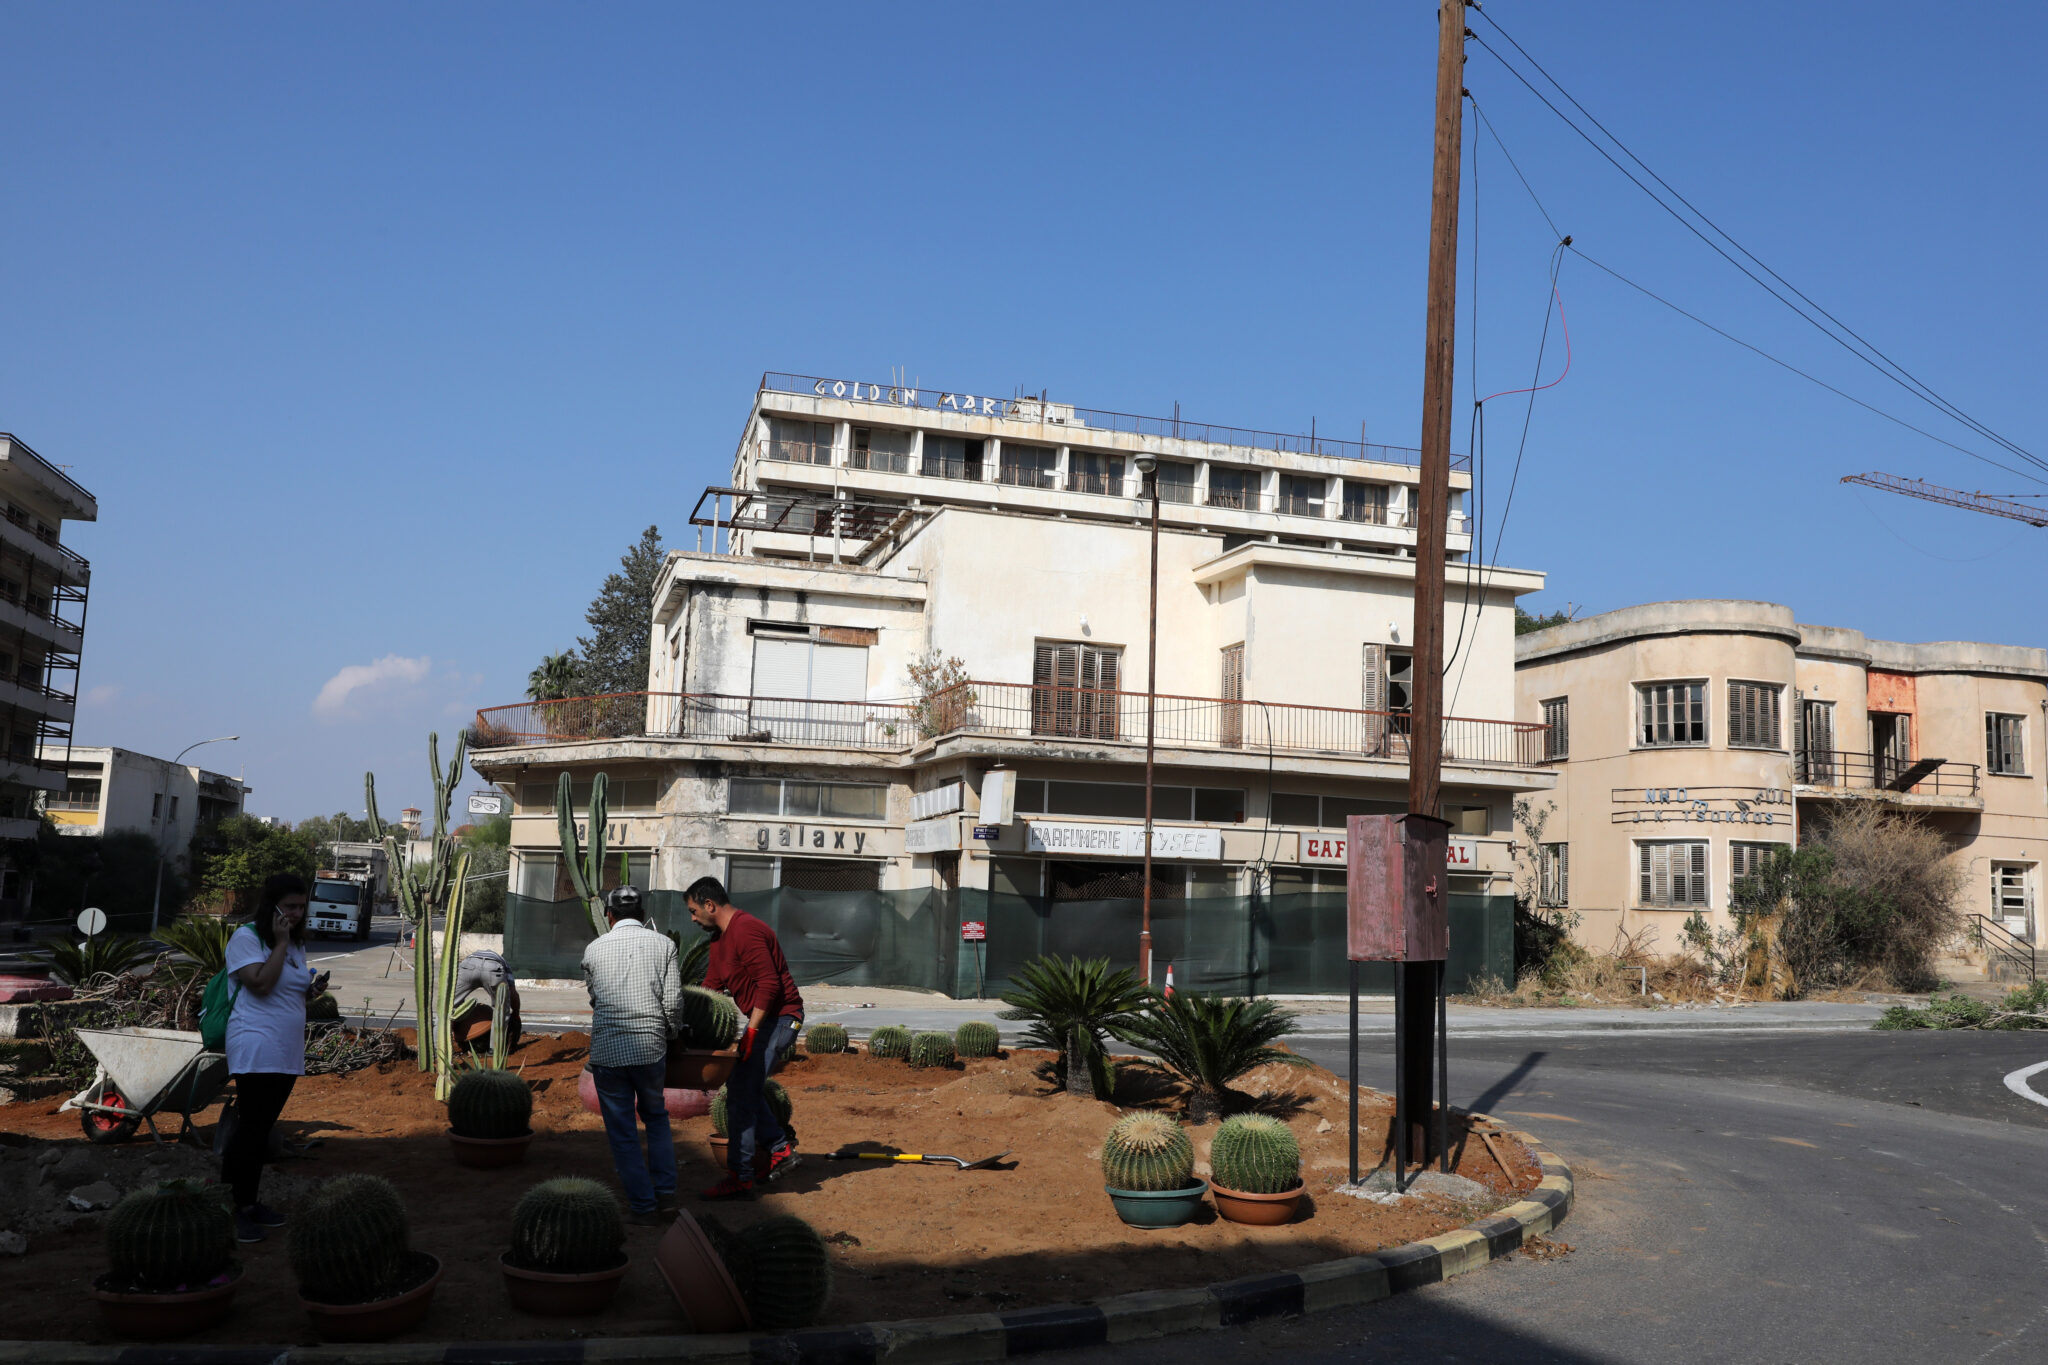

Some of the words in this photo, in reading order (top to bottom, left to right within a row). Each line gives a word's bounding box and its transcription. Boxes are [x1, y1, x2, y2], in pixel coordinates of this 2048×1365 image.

[814, 380, 916, 405] GOLDEN
[937, 393, 1057, 423] MARIANA
[1682, 810, 1773, 825] TSOKKOS
[757, 825, 866, 854] galaxy
[1031, 827, 1121, 850] PARFUMERIE
